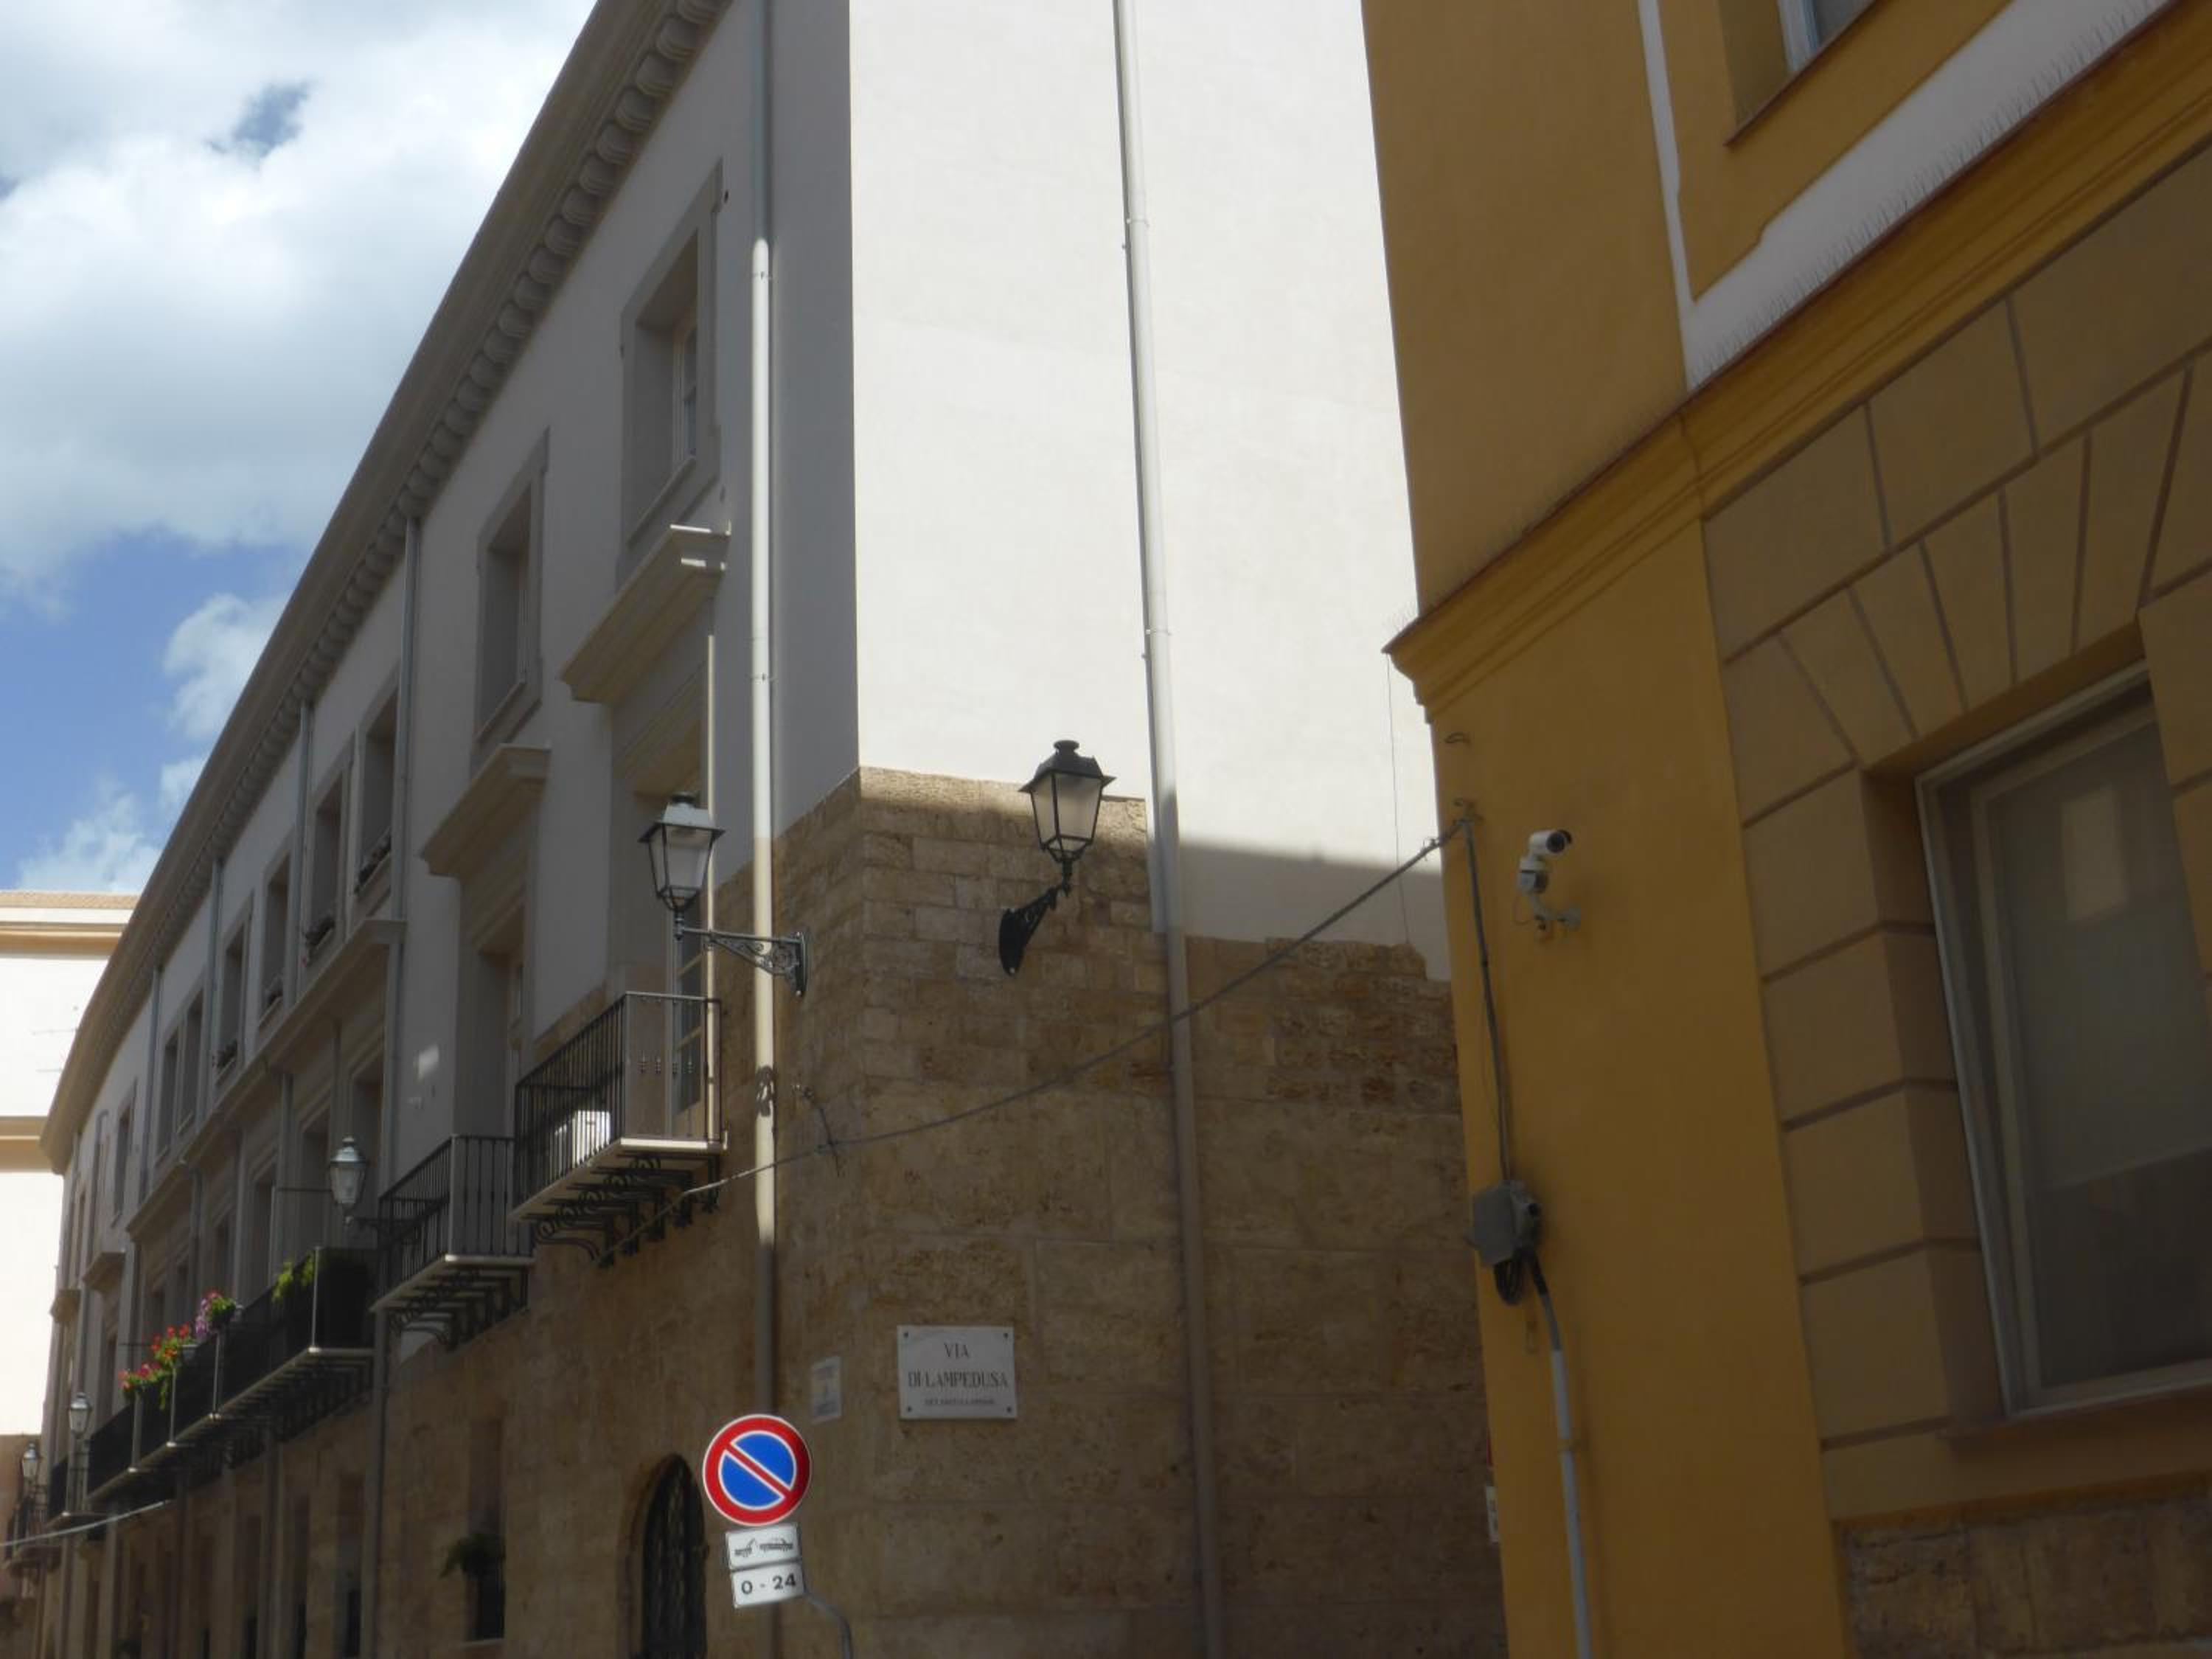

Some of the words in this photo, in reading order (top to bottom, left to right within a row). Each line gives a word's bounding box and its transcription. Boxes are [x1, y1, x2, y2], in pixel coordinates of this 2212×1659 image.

[944, 1343, 970, 1358] VIA
[908, 1371, 921, 1387] DI
[925, 1371, 1009, 1388] LAMPEDUSA
[772, 1573, 796, 1590] 24
